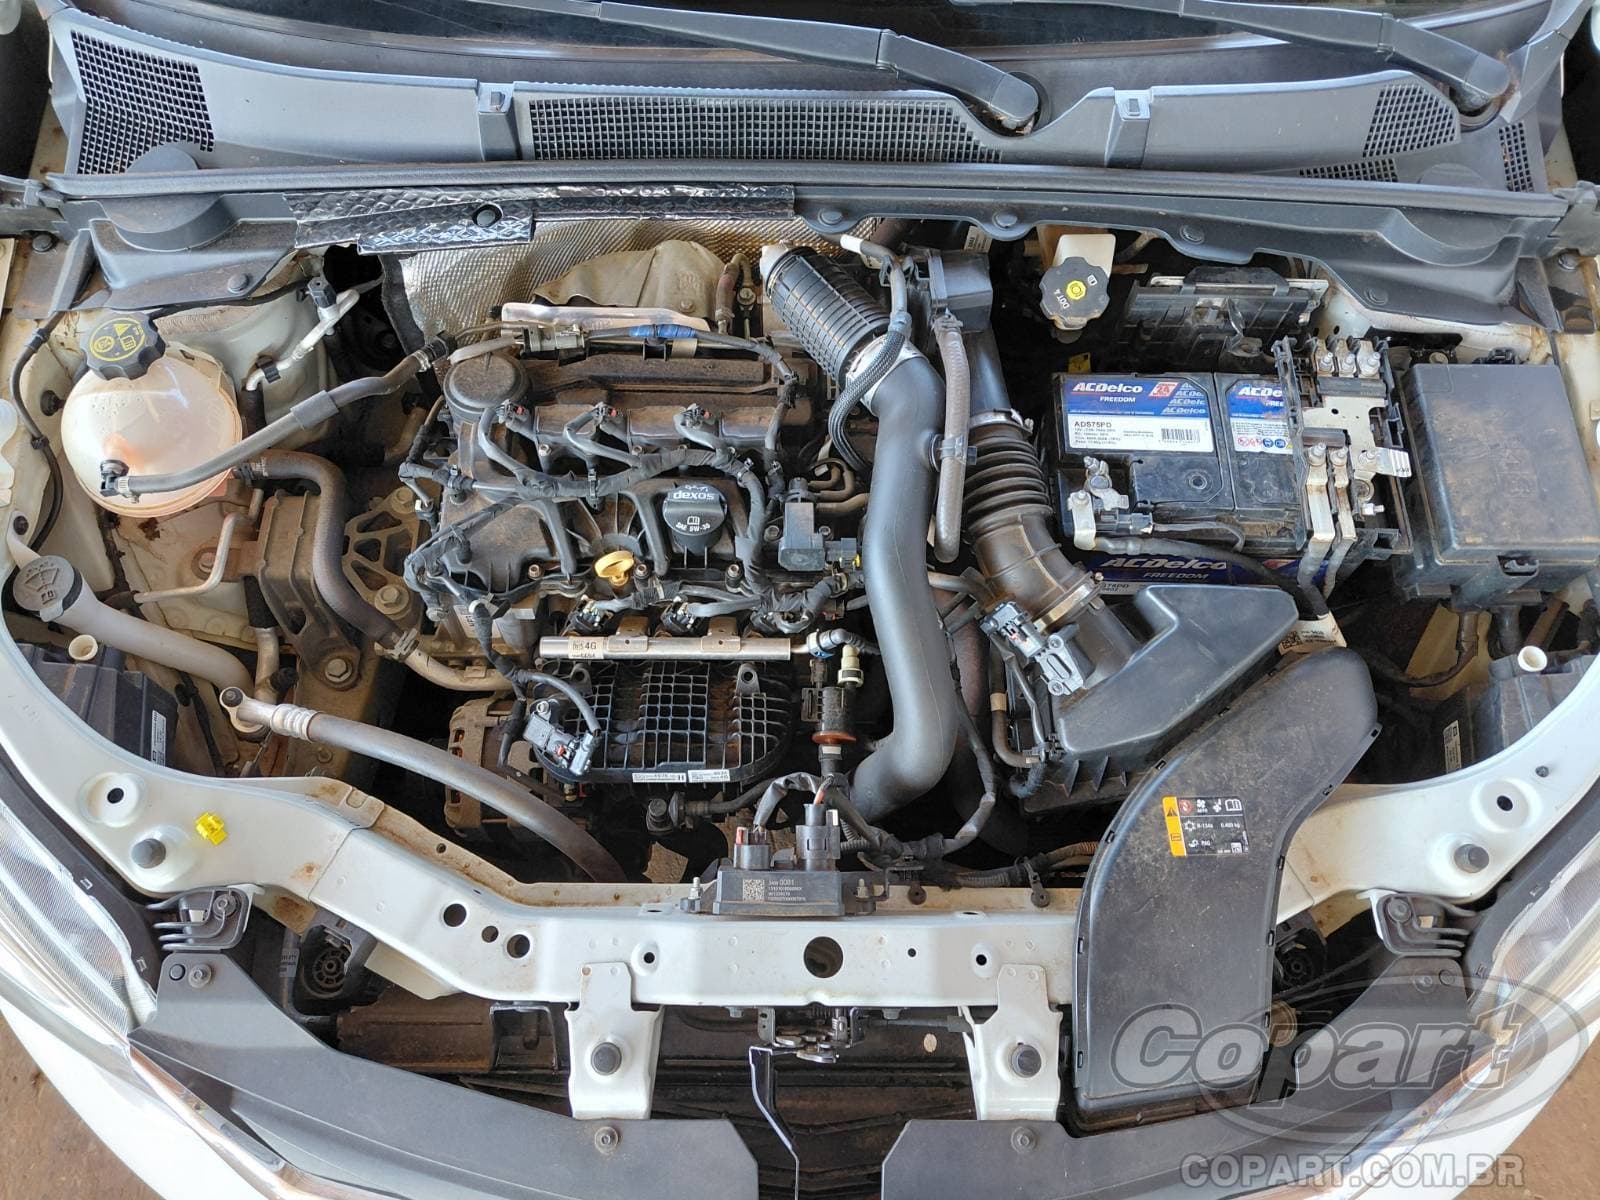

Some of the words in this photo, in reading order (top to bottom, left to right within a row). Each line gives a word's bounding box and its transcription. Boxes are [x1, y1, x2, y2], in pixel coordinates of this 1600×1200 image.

[1056, 294, 1070, 309] DOT
[1072, 382, 1143, 393] ACDelco
[1238, 386, 1283, 397] ACDe
[673, 490, 716, 500] dexos
[1102, 558, 1227, 570] ACDelco
